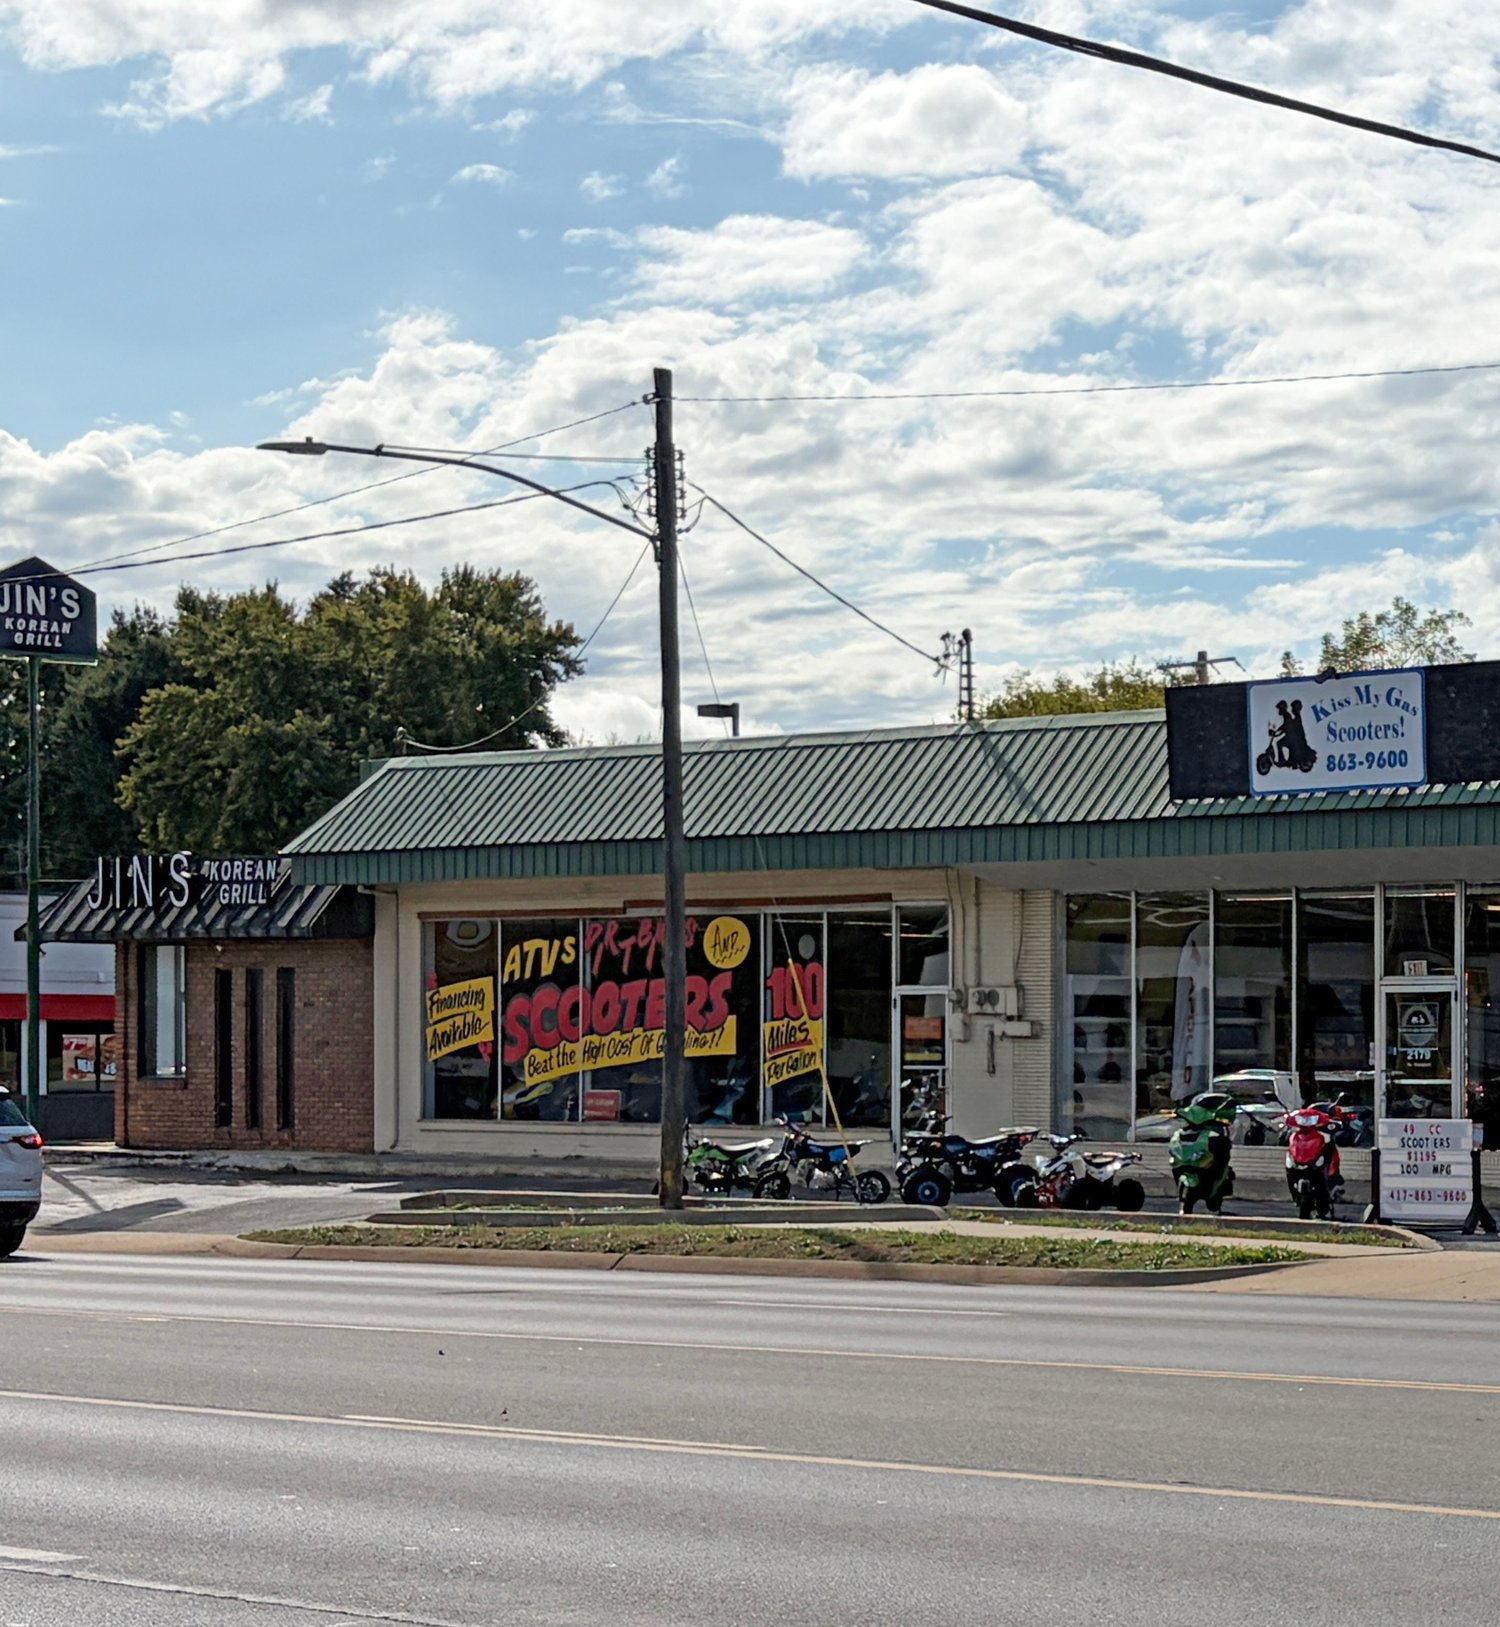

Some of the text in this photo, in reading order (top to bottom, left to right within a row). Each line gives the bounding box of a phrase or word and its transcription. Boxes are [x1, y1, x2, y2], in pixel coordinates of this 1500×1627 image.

[0, 583, 80, 619] JIN'S
[5, 617, 71, 634] KOREAN
[14, 632, 62, 647] GRILL
[1311, 684, 1418, 723] Kiss My Gas
[1327, 715, 1405, 743] Scooters!
[1326, 749, 1408, 772] 863-9600
[88, 853, 190, 909] JIN'S
[210, 860, 276, 881] KOREAN
[220, 883, 267, 904] GRILL
[429, 984, 486, 1019] Financing
[766, 961, 824, 1019] 100
[503, 971, 733, 1065] SCOOTERS
[768, 1021, 809, 1051] Miles
[527, 1053, 554, 1077] Beat
[556, 1043, 576, 1067] the
[1403, 1124, 1442, 1135] 49 CC
[1400, 1164, 1451, 1175] 100 MPG
